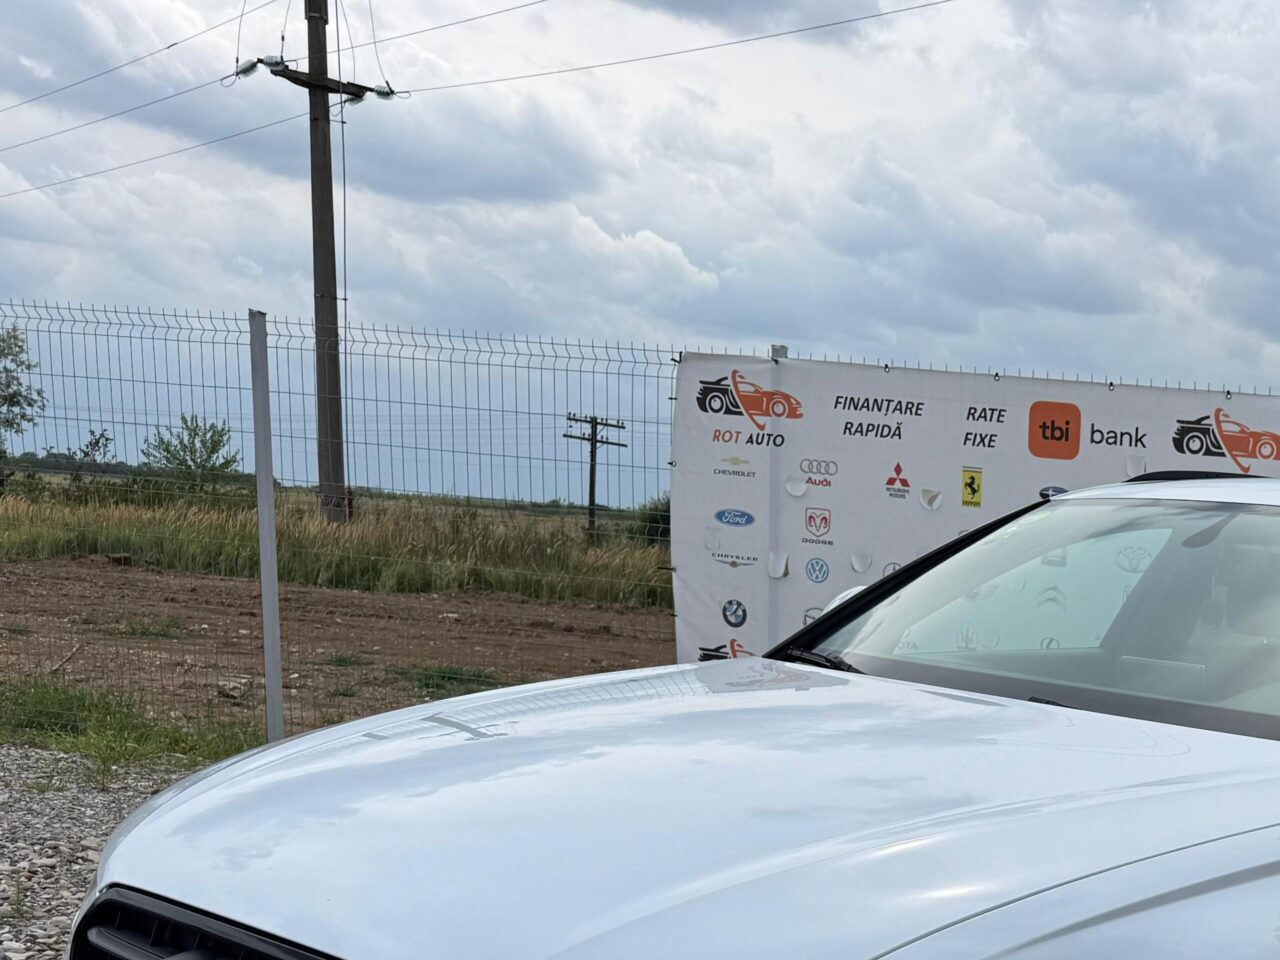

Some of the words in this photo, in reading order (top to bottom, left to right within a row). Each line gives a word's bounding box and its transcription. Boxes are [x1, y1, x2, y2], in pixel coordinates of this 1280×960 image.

[833, 395, 925, 417] FINANȚARE
[965, 406, 1006, 424] RATE
[712, 429, 742, 443] ROT
[745, 433, 785, 447] AUTO
[843, 421, 904, 440] RAPIDĂ
[1039, 420, 1071, 442] tbi
[1090, 425, 1148, 449] bank
[963, 432, 998, 449] FIXE
[722, 511, 748, 524] Ford
